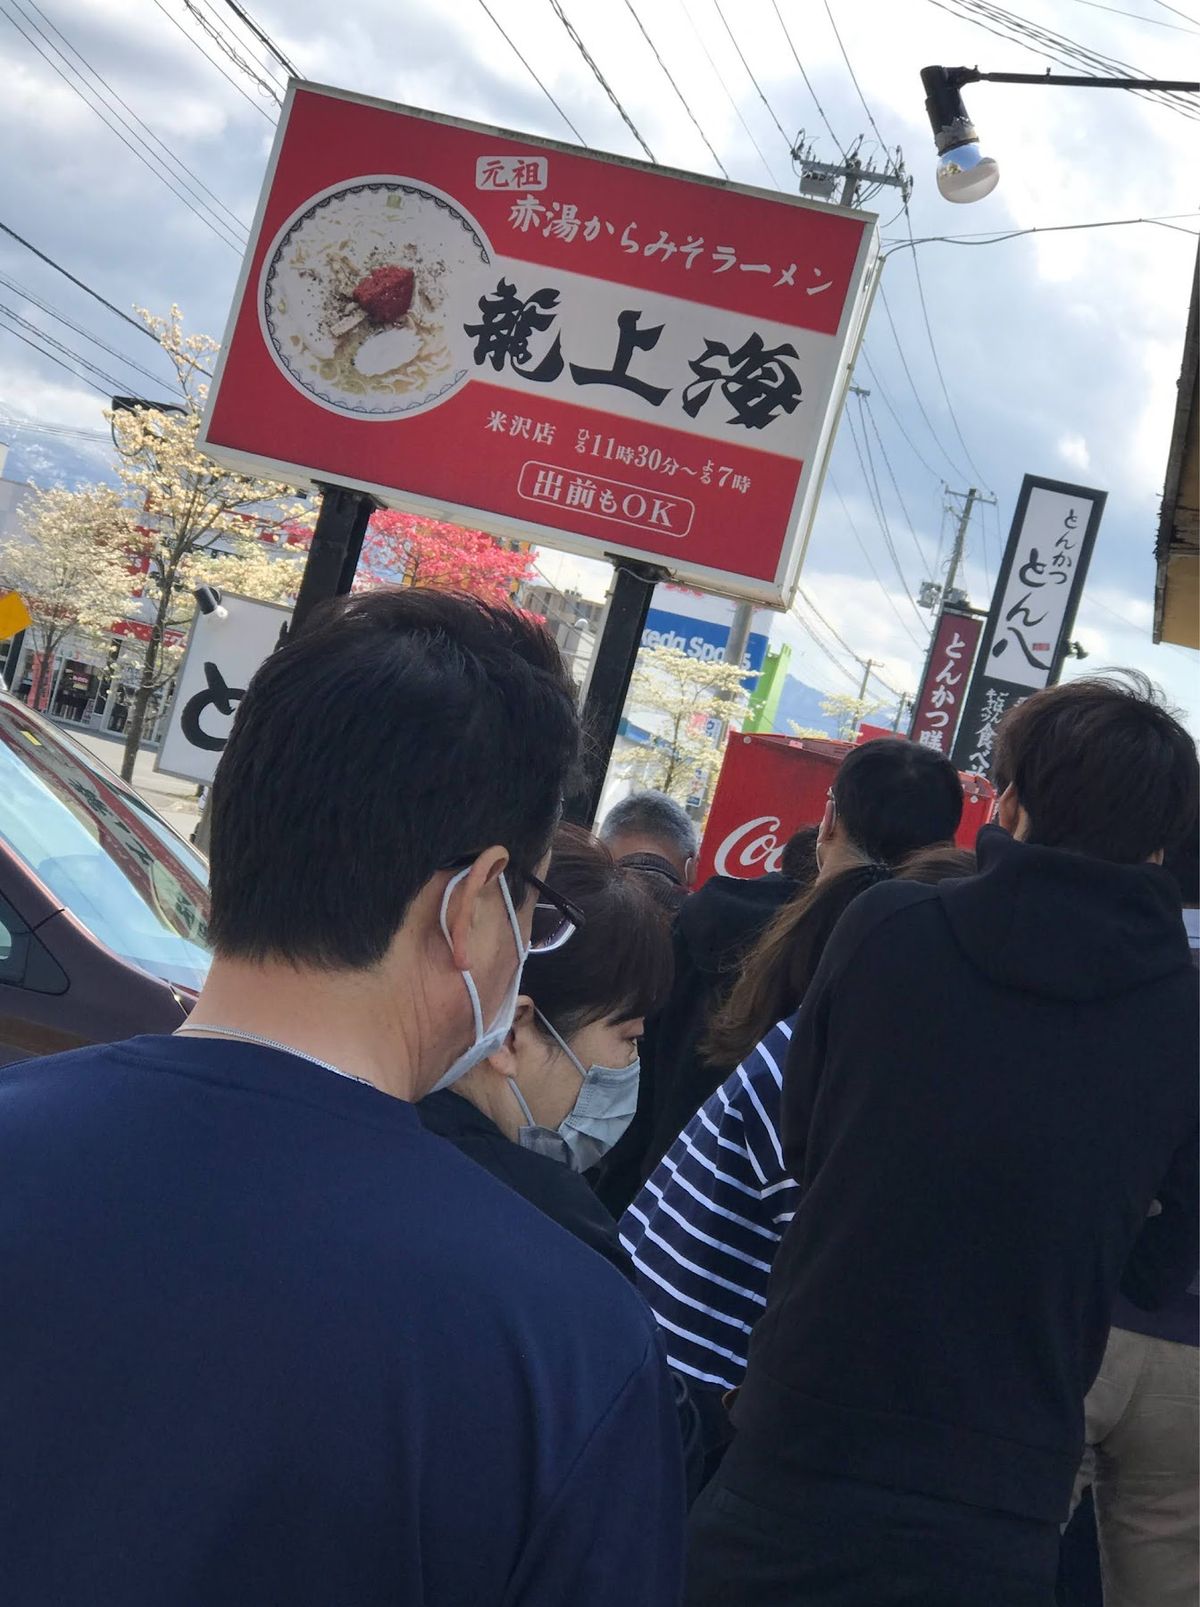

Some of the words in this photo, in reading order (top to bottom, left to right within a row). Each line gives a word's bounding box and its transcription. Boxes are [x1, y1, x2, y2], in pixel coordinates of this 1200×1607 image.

[481, 159, 542, 189] 元祖
[508, 194, 833, 296] 赤湯からみそラーメン
[463, 276, 803, 430] 龍上海
[484, 410, 556, 445] 米沢店
[532, 469, 678, 528] 出前もOK
[1048, 508, 1079, 585] とんかつ
